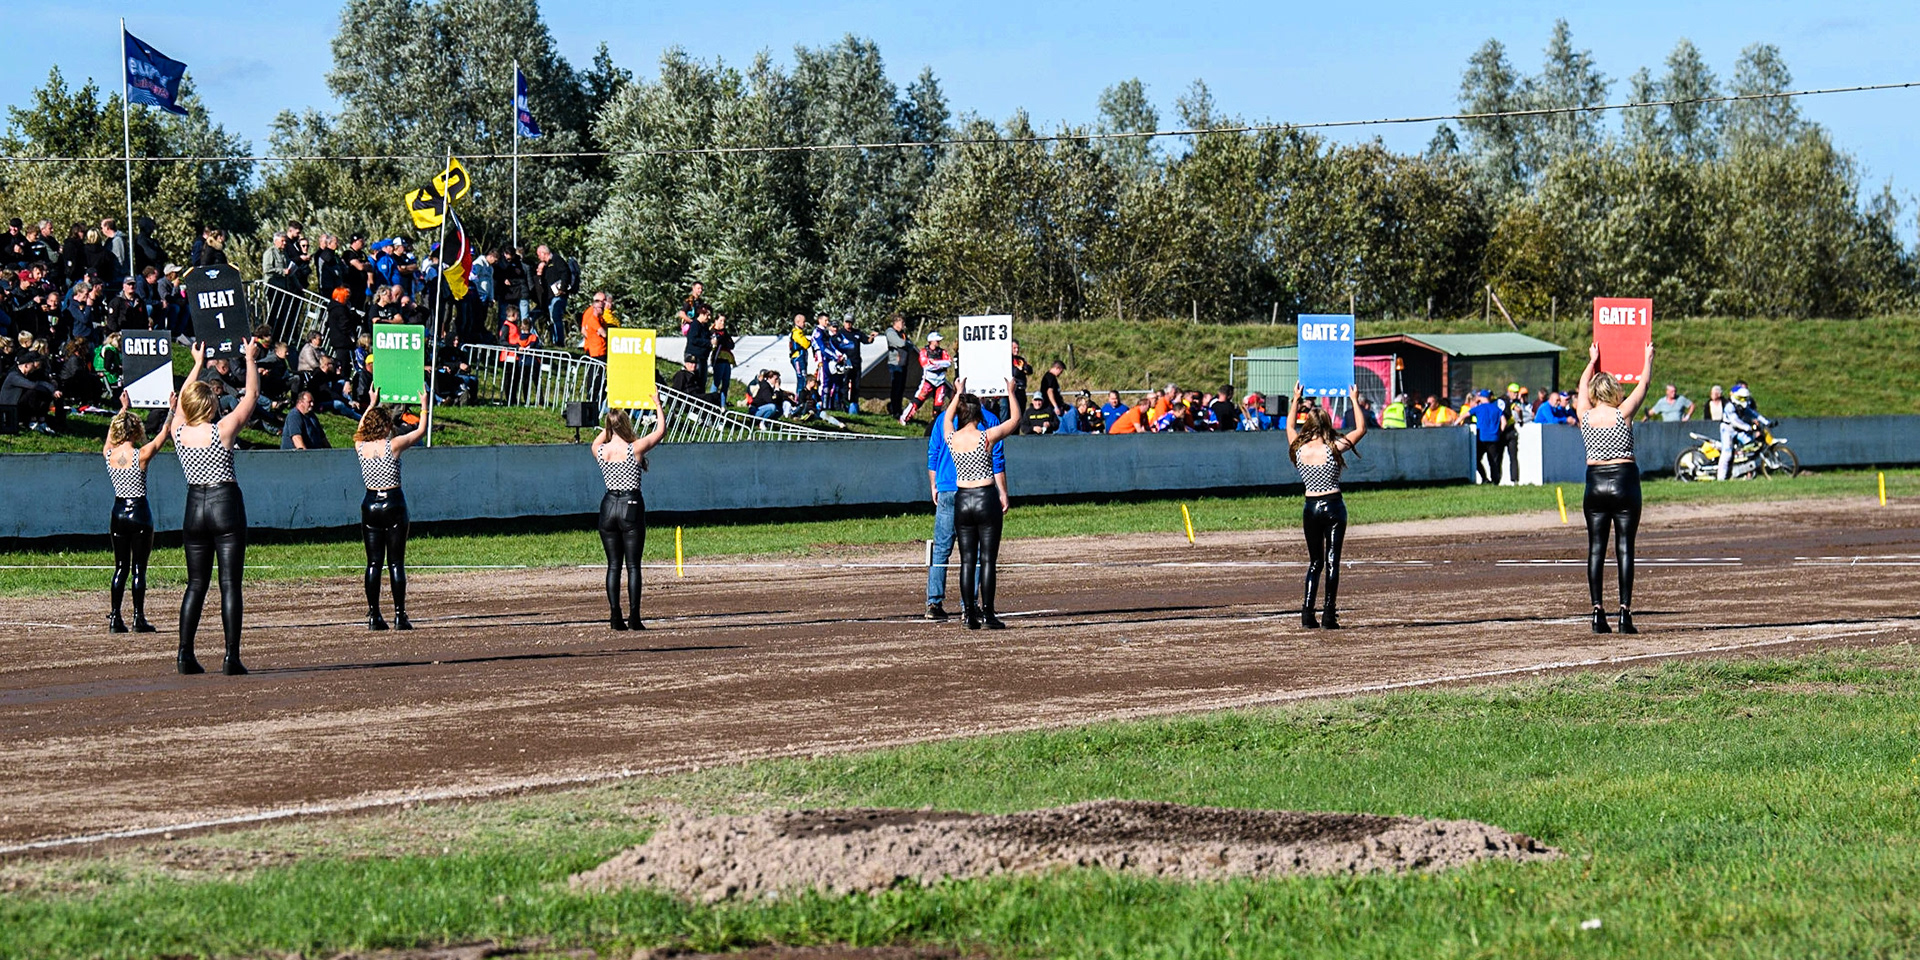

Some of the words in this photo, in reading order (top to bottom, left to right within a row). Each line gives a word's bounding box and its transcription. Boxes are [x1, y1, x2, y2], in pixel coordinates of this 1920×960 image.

[198, 290, 235, 309] HEAT
[215, 312, 225, 329] 1
[1599, 307, 1636, 325] GATE
[1638, 307, 1647, 325] 1
[376, 332, 409, 350] GATE
[411, 334, 421, 350] 5
[962, 325, 996, 341] GATE
[998, 324, 1008, 340] 3
[1301, 323, 1338, 341] GATE
[1340, 323, 1351, 341] 2
[124, 337, 157, 355] GATE
[158, 338, 169, 355] 6
[611, 336, 642, 354] GATE
[643, 338, 652, 355] 4
